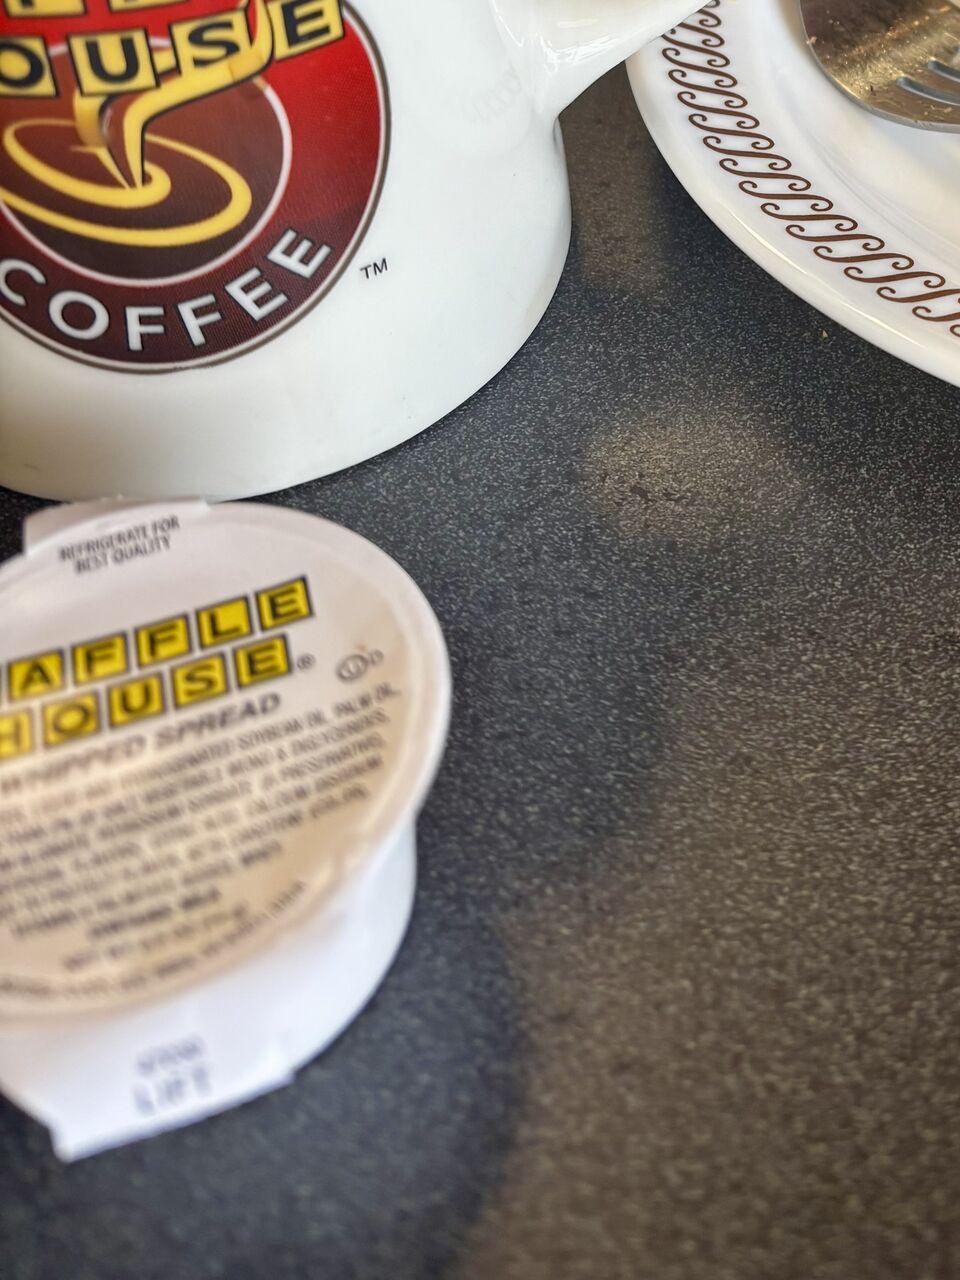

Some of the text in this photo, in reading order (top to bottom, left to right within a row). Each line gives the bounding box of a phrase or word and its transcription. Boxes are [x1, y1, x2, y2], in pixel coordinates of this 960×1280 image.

[0, 228, 332, 352] COFFEE
[59, 514, 180, 562] REFRIGERATE FOR
[76, 533, 170, 573] BEST QUALITY
